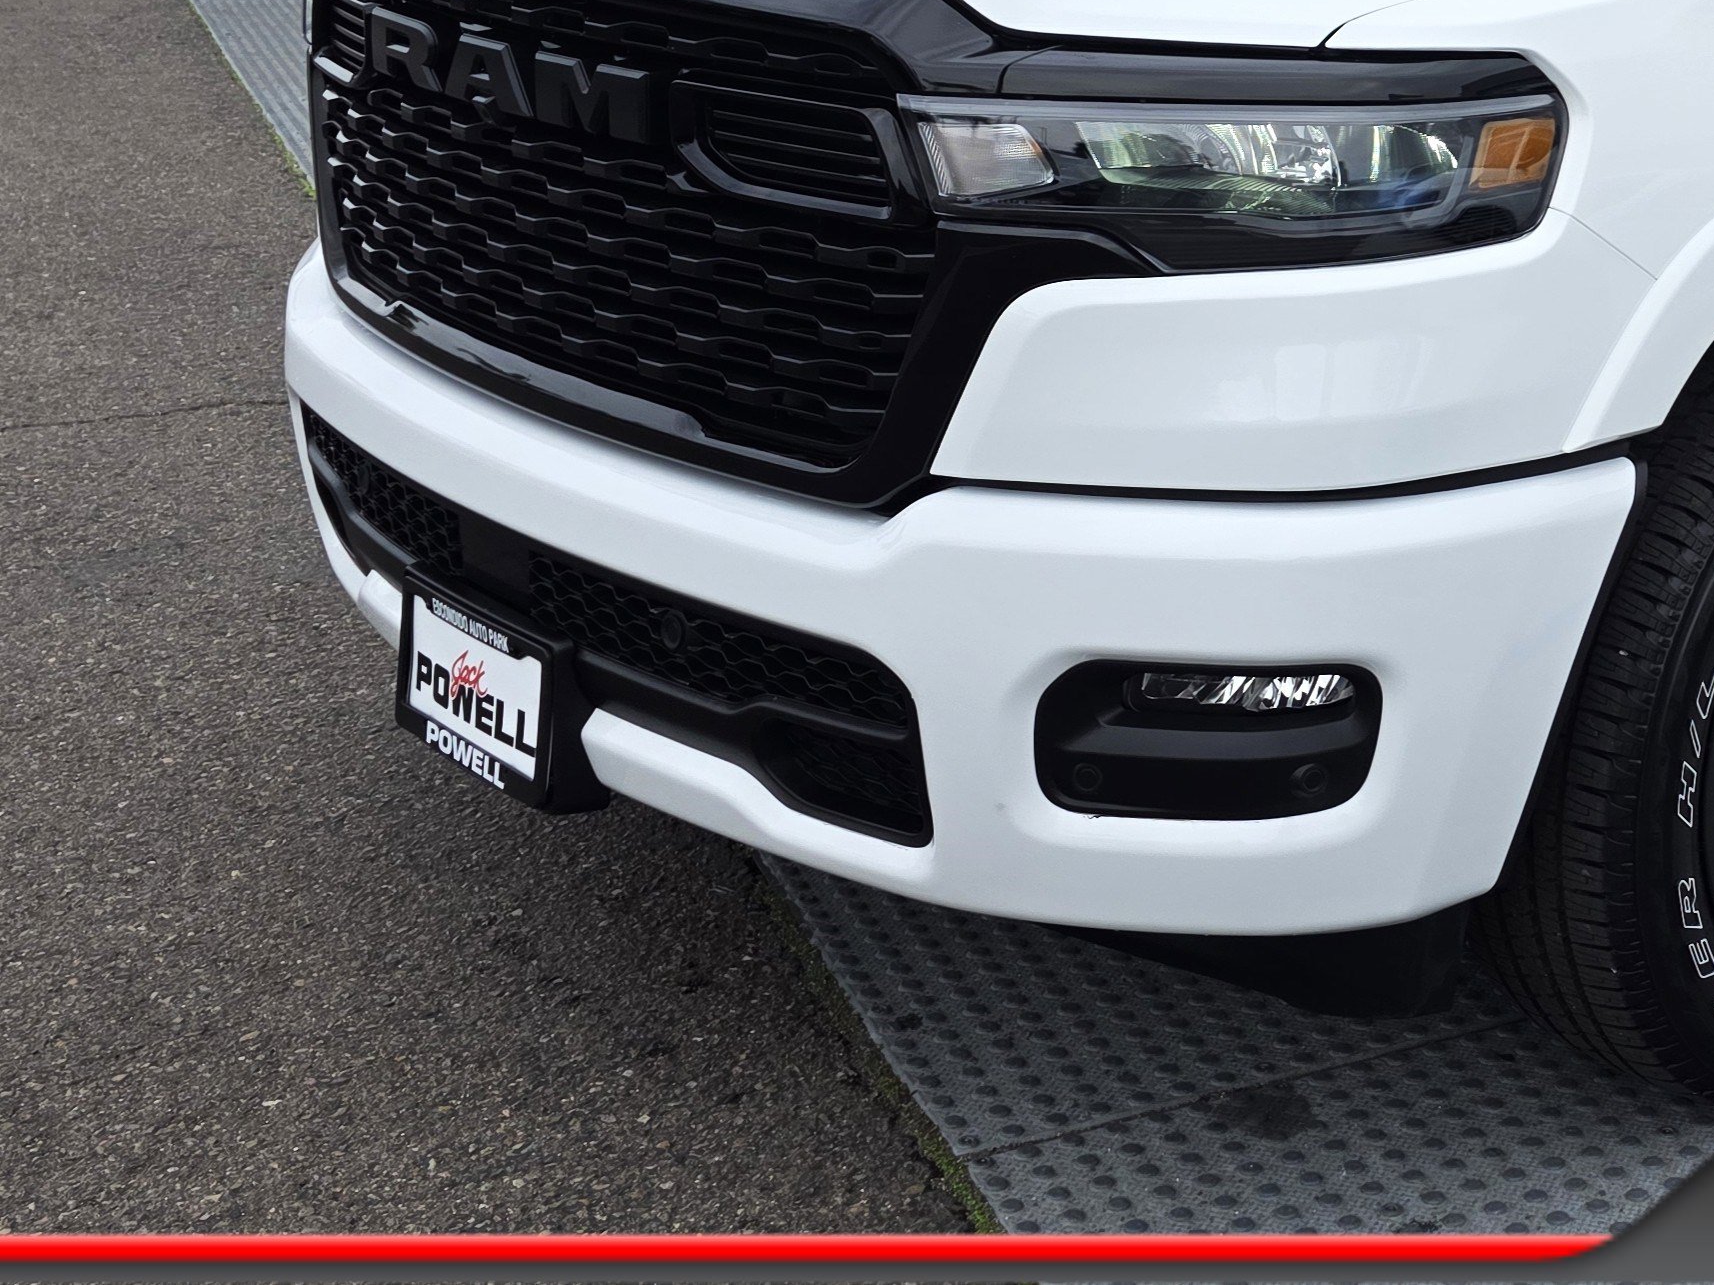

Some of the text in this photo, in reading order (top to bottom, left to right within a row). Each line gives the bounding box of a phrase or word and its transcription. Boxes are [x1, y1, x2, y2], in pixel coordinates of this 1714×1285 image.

[371, 6, 649, 144] RAM
[450, 650, 488, 698] Jack
[488, 628, 509, 653] PARK
[416, 650, 536, 758] POWELL
[426, 720, 505, 790] POWELL
